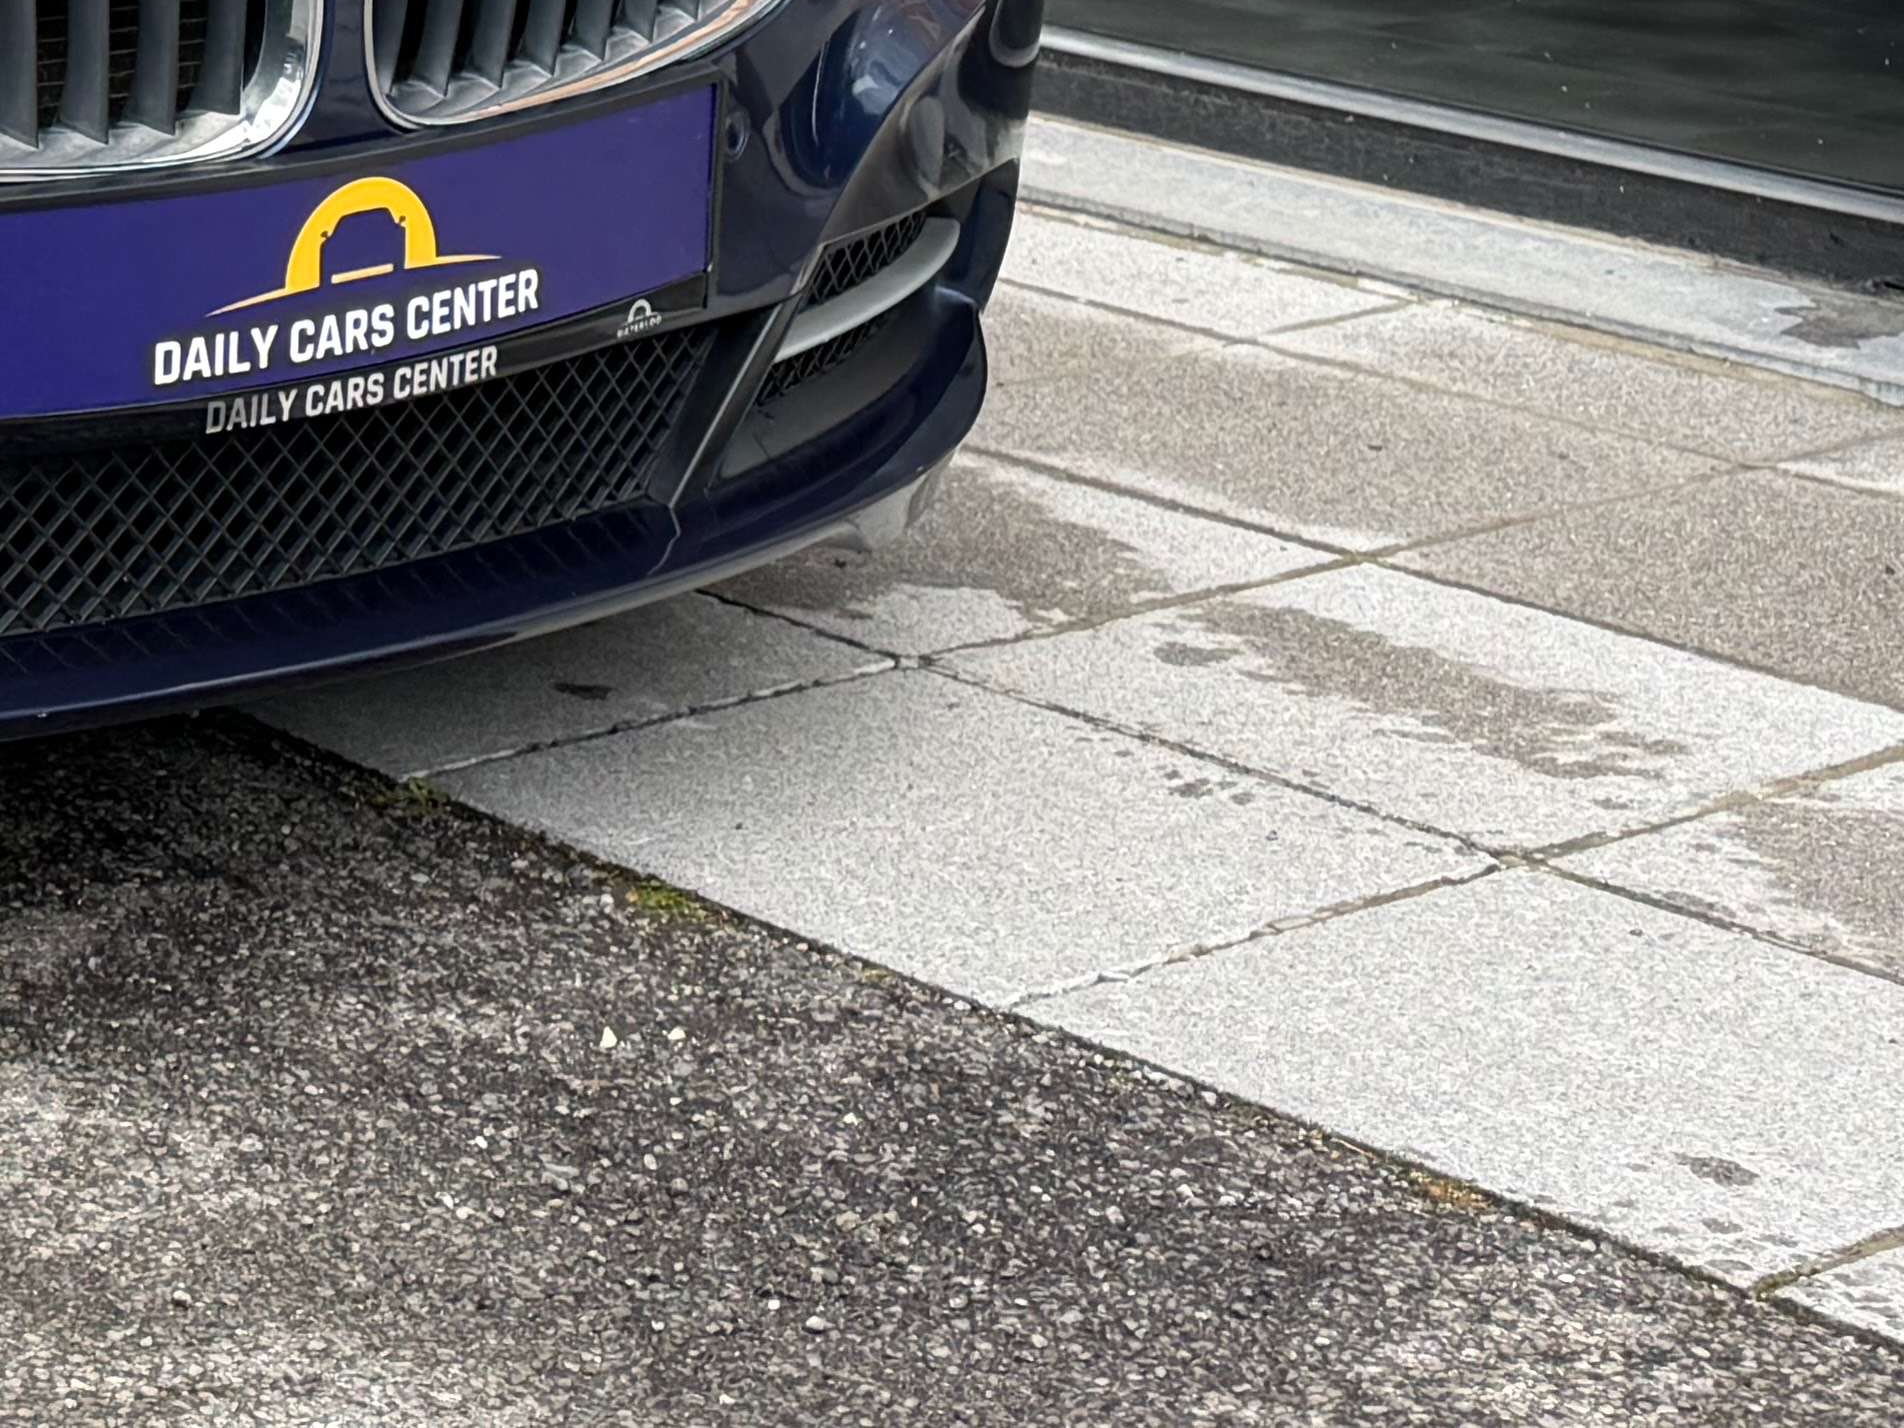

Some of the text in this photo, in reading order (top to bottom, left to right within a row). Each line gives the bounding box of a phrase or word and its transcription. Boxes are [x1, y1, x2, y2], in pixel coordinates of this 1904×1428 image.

[154, 267, 541, 386] DAILY CARS CENTER
[205, 345, 499, 436] DAILY CARS CENTER
